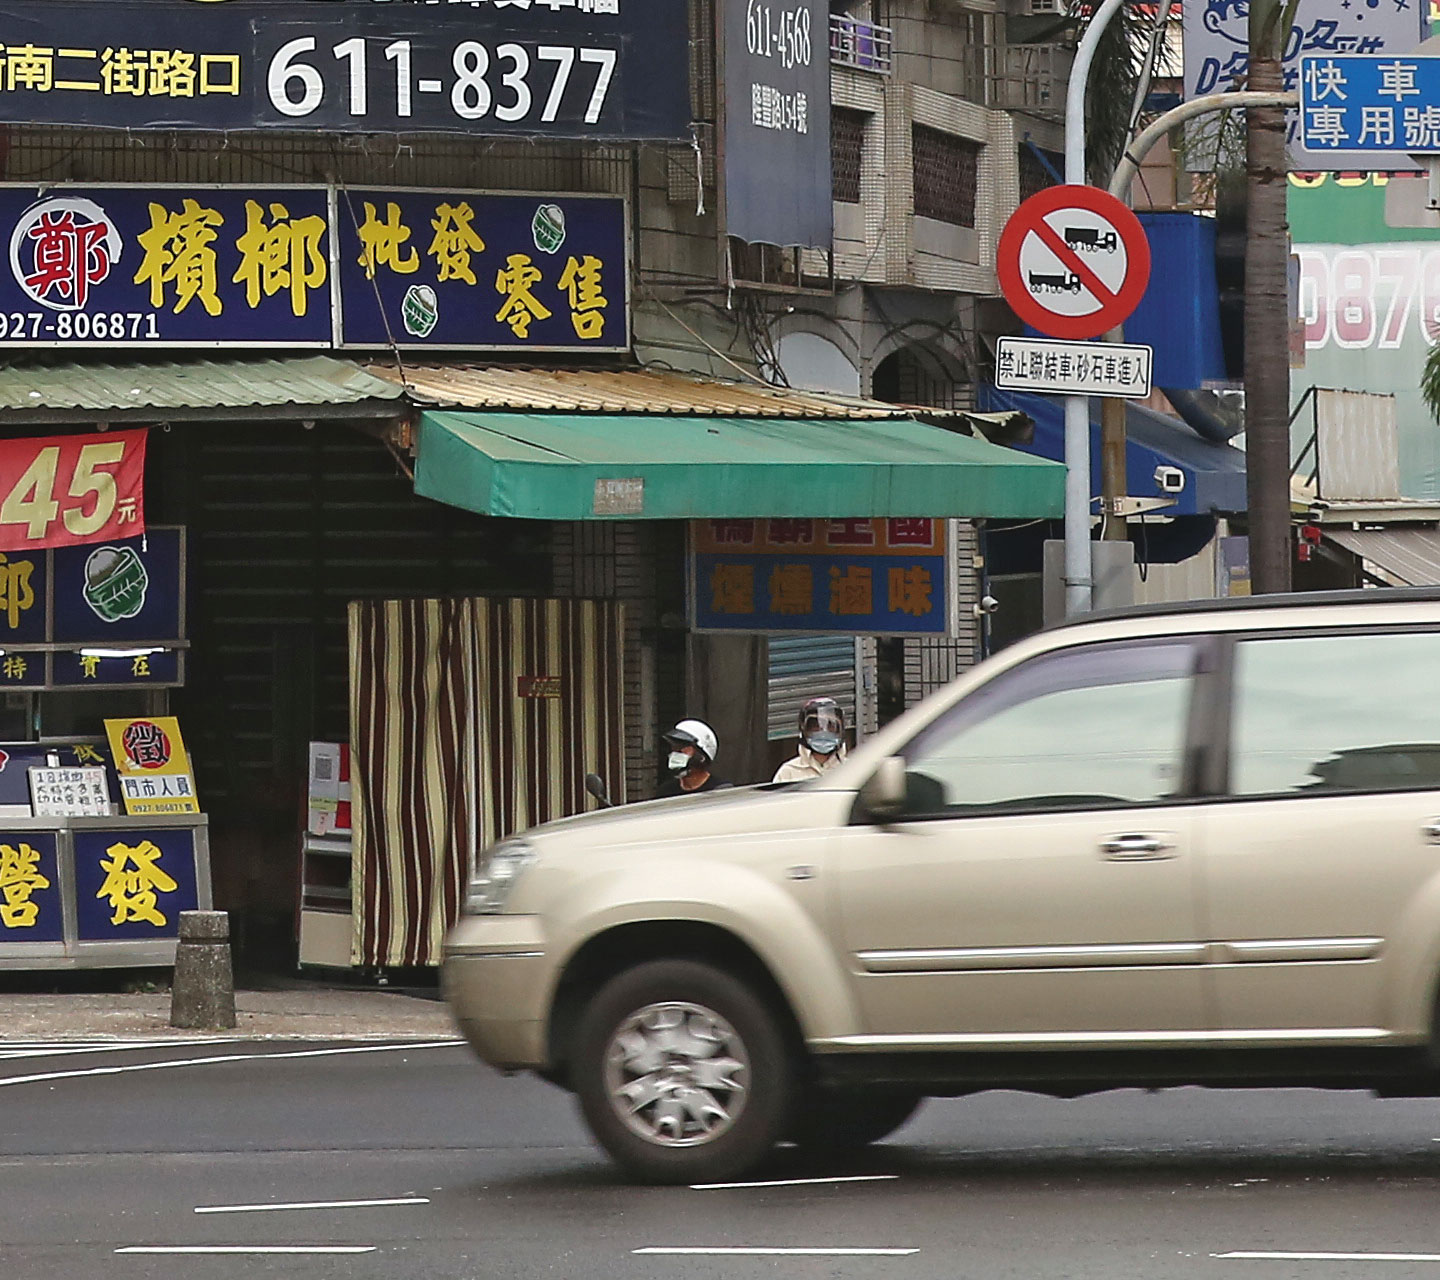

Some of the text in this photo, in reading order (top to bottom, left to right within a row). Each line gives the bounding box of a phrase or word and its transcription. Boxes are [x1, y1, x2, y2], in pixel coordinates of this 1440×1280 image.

[266, 36, 617, 124] 611-8377
[24, 207, 110, 311] 鄭
[133, 198, 326, 318] 檳榔
[357, 202, 609, 340] 批發 零售
[123, 724, 170, 765] 徵
[124, 776, 192, 798] 門市人員
[96, 840, 180, 926] 發
